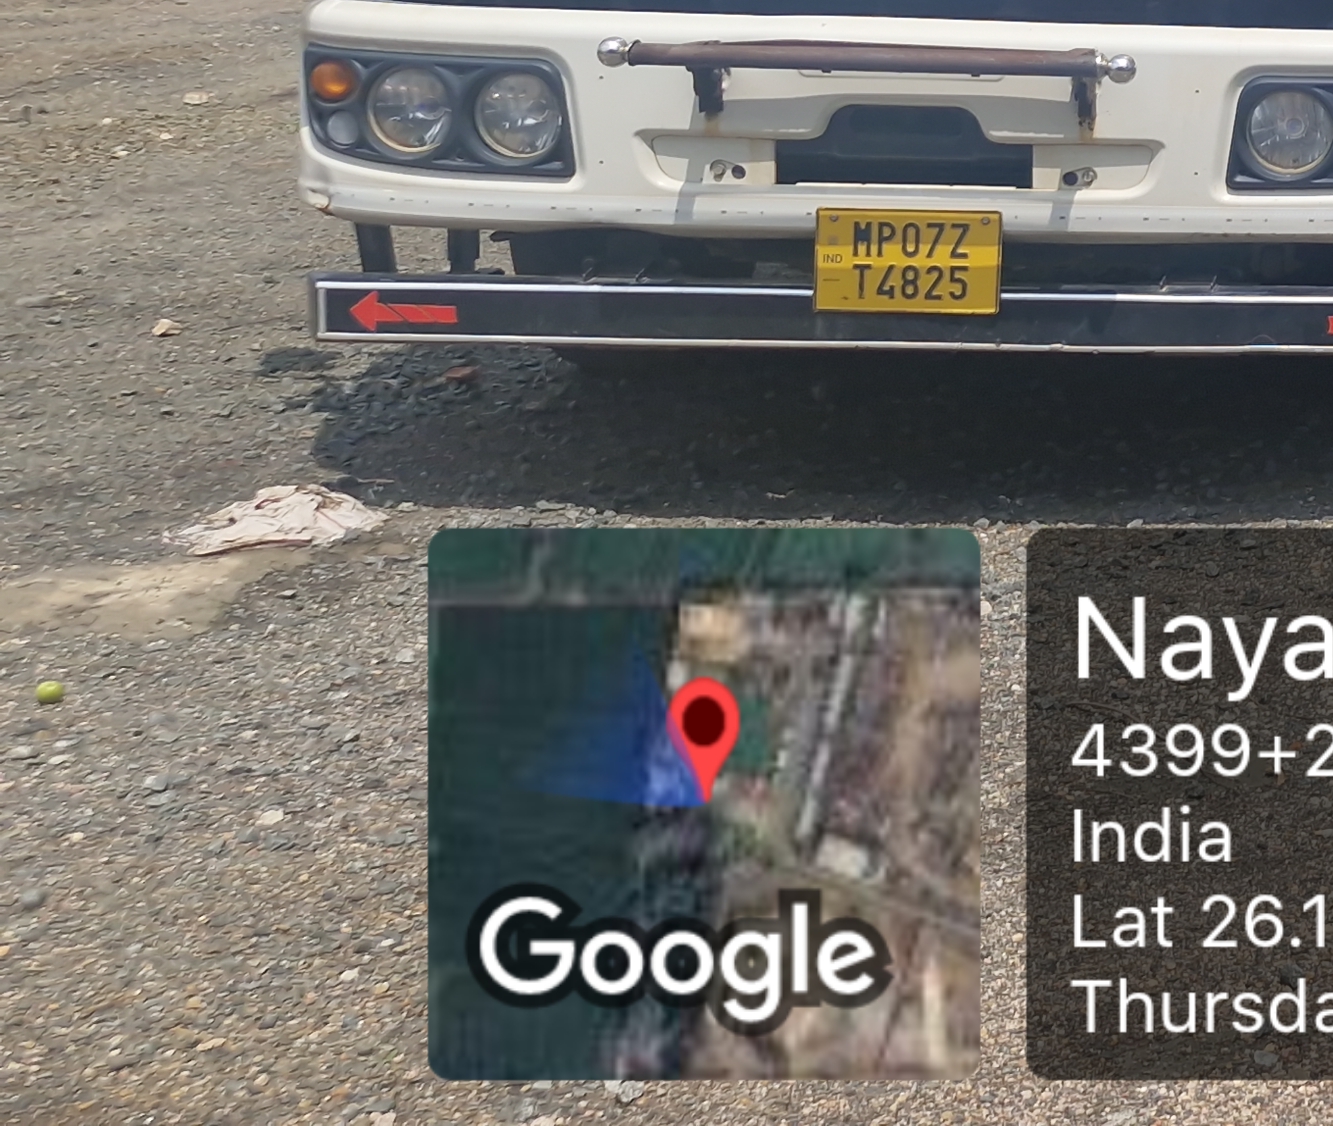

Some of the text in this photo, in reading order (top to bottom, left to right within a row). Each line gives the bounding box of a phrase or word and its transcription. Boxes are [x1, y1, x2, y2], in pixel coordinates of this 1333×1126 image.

[822, 253, 843, 264] IND
[852, 221, 971, 260] MP07Z
[852, 263, 970, 301] T4825
